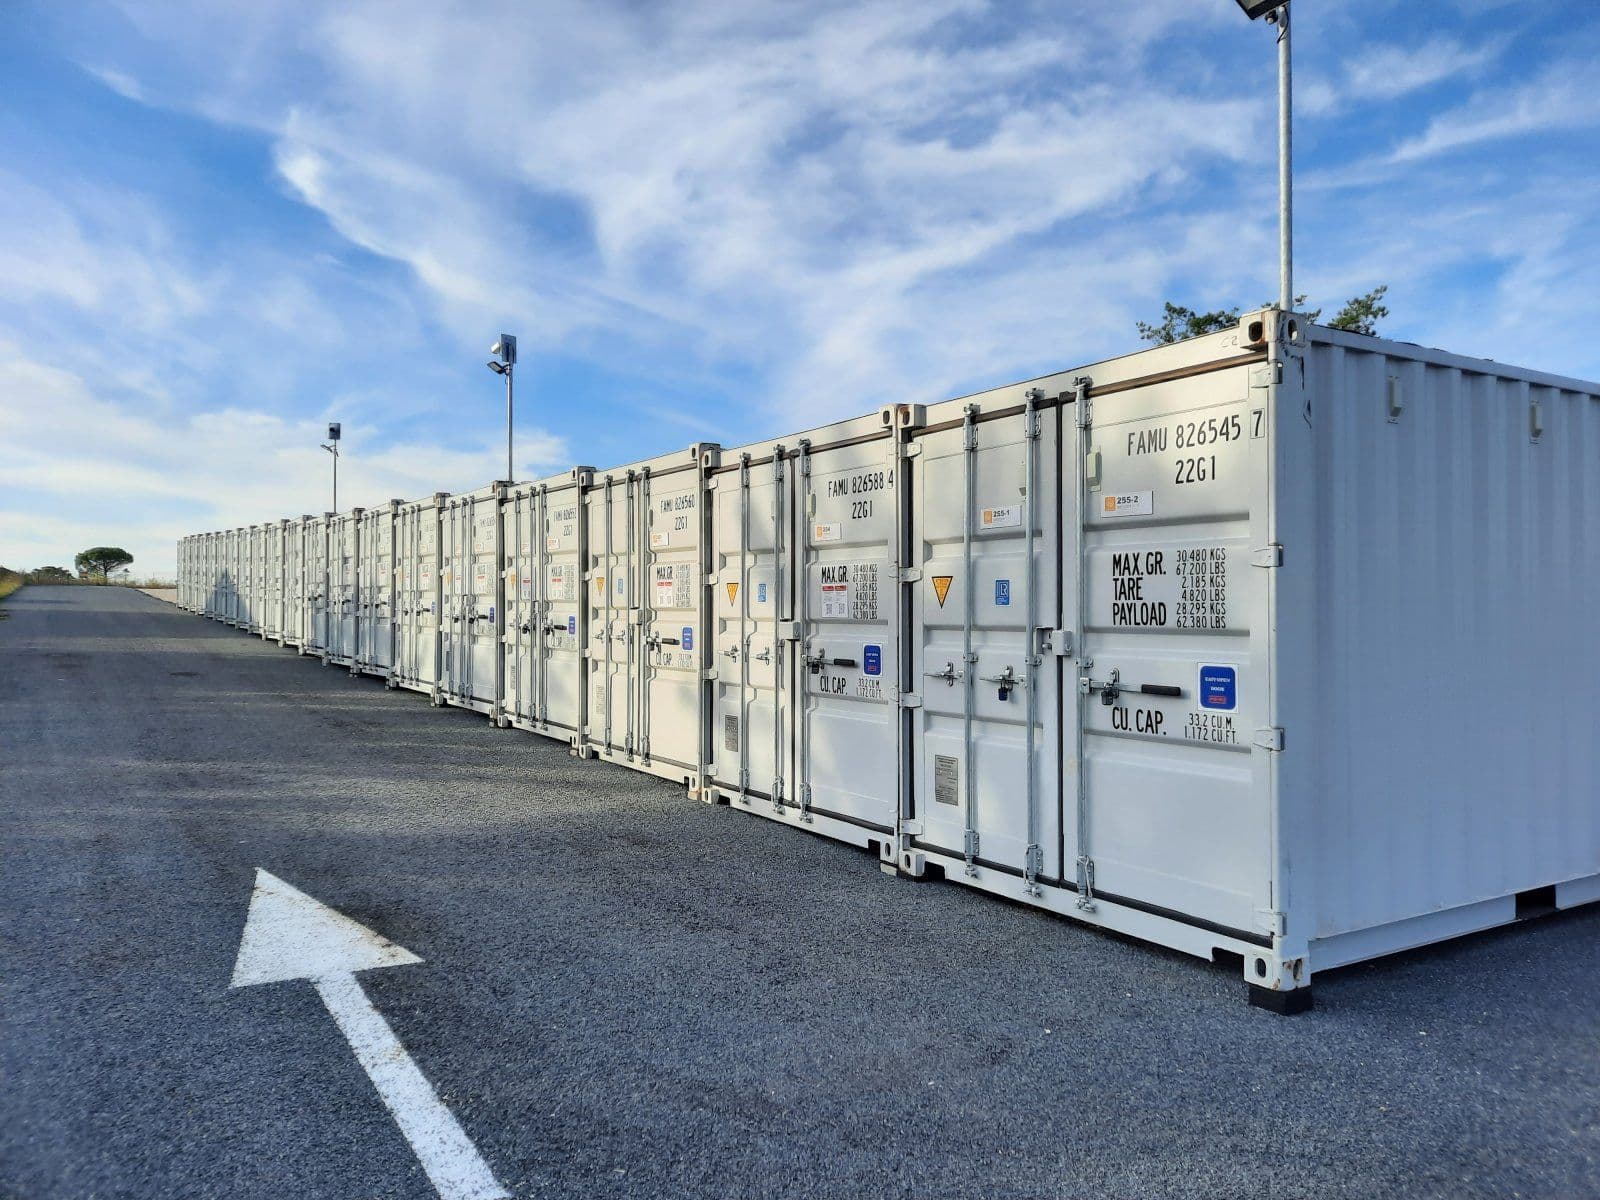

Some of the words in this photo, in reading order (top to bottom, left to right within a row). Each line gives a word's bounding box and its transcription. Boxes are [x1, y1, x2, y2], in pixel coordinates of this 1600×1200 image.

[1128, 427, 1167, 456] FAMU
[1176, 414, 1241, 449] 826545
[1253, 410, 1263, 437] 7
[1175, 455, 1216, 485] 22G1
[828, 478, 849, 498] FAMU
[852, 471, 884, 494] 826588
[888, 469, 894, 488] 4
[1117, 495, 1139, 504] 255-2
[852, 500, 873, 519] 22G1
[1176, 549, 1207, 563] 30.480
[1210, 548, 1226, 561] KGS
[1175, 562, 1207, 575] 67.200
[1210, 561, 1226, 574] LBS
[1112, 577, 1144, 601] TARE
[1181, 575, 1207, 588] 2.185
[1210, 575, 1226, 588] KGS
[1181, 588, 1207, 602] 4.820
[1210, 588, 1226, 602] LBS
[1112, 602, 1167, 626] PAYLOAD
[1176, 602, 1207, 615] 28.295
[1210, 602, 1226, 615] KGS
[1176, 615, 1207, 629] 62.380
[1210, 615, 1226, 629] LBS
[1188, 713, 1208, 727] 33.2
[1184, 725, 1208, 740] 1.172
